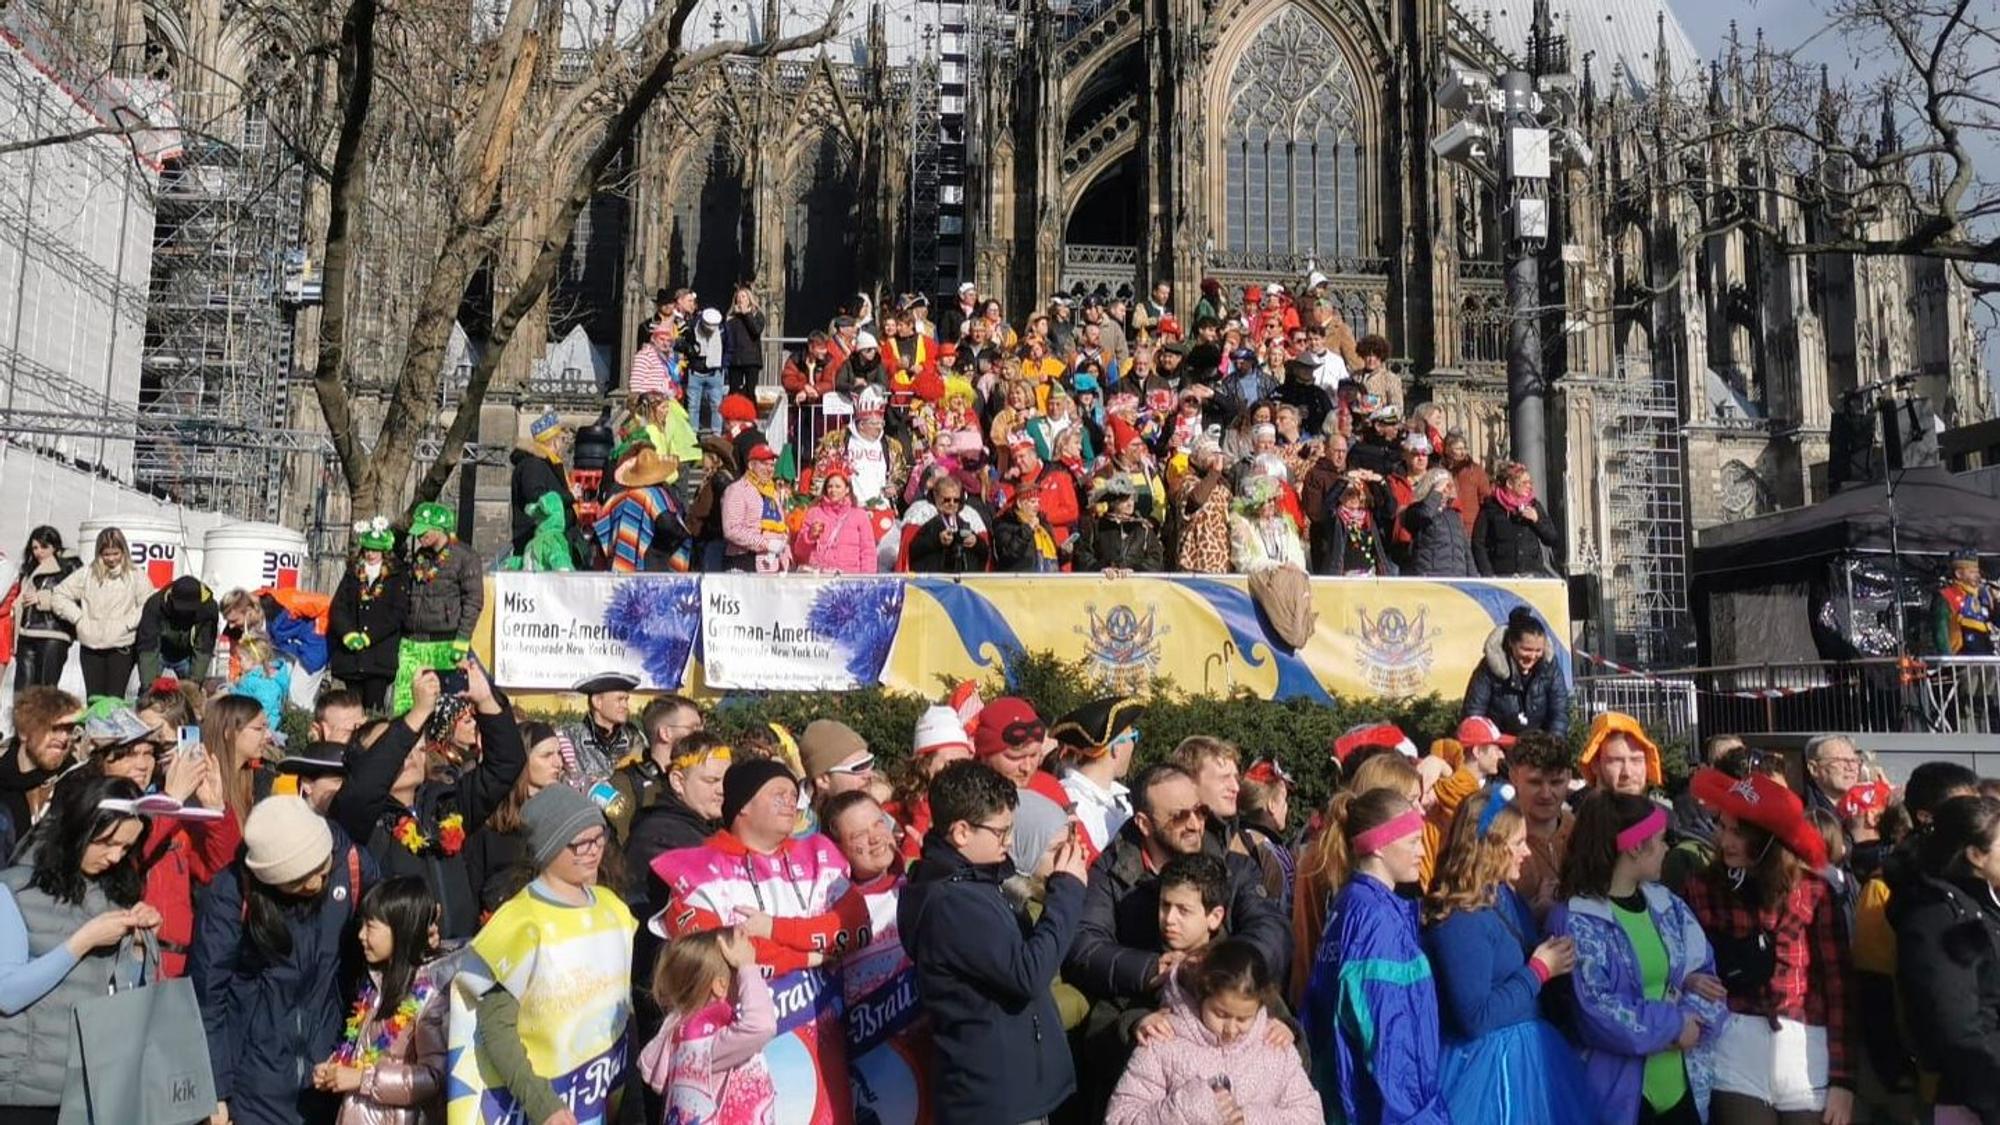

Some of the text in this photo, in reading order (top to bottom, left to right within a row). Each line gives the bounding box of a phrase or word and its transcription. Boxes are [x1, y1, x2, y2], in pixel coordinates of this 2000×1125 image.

[504, 591, 535, 613] Miss
[709, 593, 740, 615] Miss
[566, 641, 585, 655] New
[588, 642, 607, 656] York
[609, 642, 626, 659] City
[771, 644, 788, 657] New
[791, 645, 810, 658] York
[813, 644, 830, 660] City
[172, 1078, 196, 1104] kik
